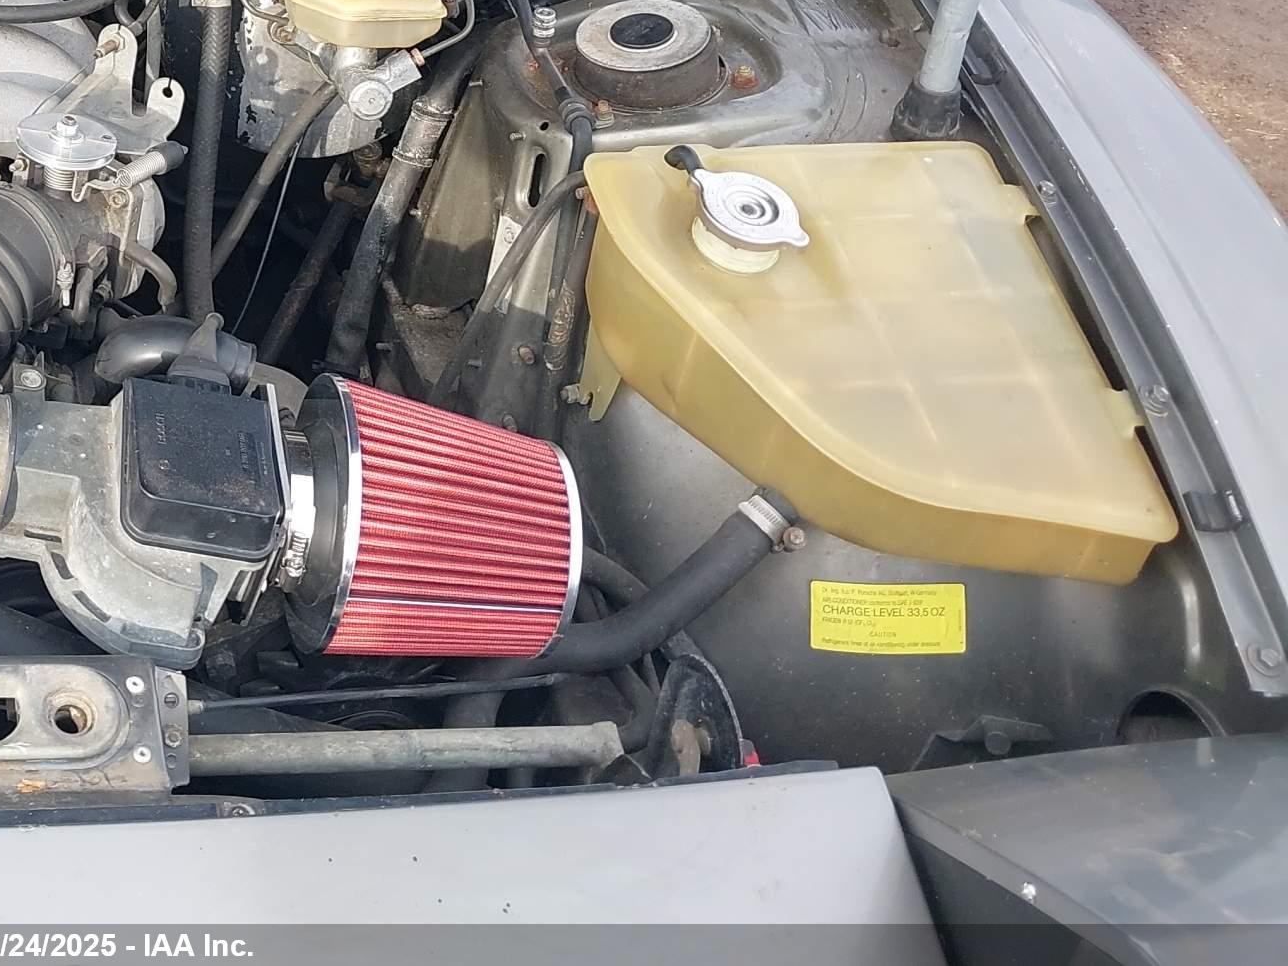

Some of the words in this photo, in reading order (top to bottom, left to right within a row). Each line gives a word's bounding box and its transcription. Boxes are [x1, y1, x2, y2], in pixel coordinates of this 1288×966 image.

[822, 604, 870, 617] CHARGE
[873, 606, 905, 617] LEVEL
[930, 606, 945, 617] OZ
